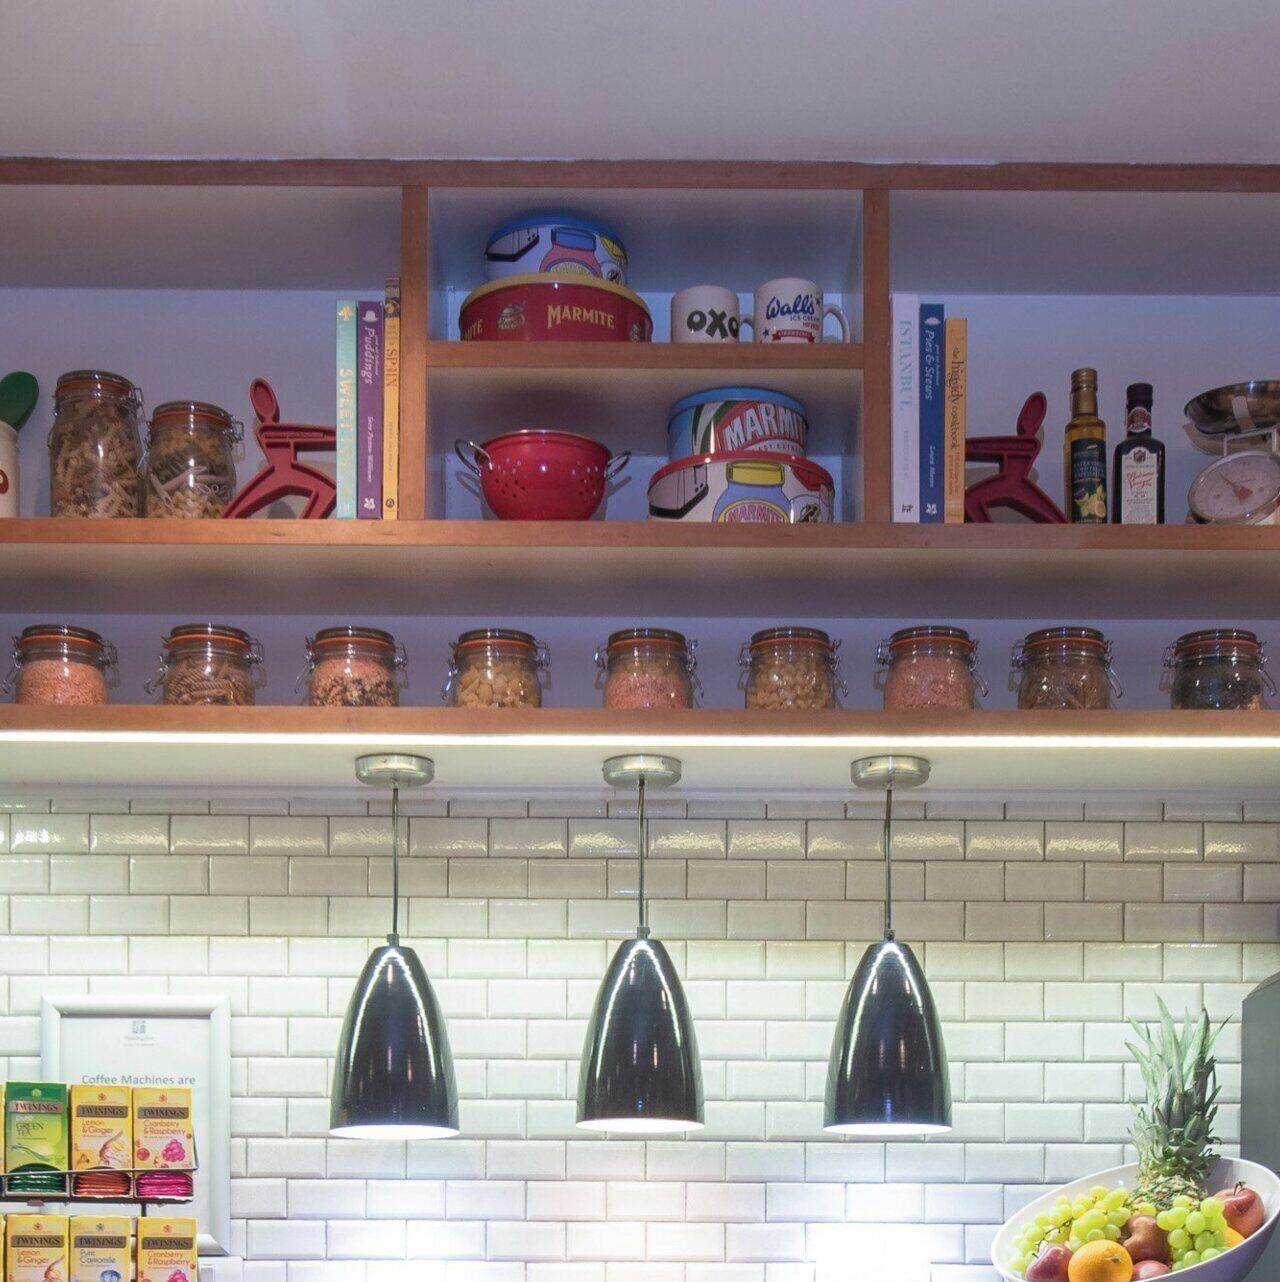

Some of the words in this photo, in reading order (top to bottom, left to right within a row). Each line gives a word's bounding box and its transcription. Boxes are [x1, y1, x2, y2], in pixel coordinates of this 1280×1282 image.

[766, 294, 816, 320] Wall's
[547, 304, 616, 330] MARMITE
[686, 308, 740, 340] OXO
[925, 330, 935, 353] Pies
[361, 327, 375, 385] Puddings
[925, 367, 935, 401] Stews
[946, 361, 964, 405] higgidy
[82, 1075, 118, 1085] Coffee
[121, 1075, 175, 1085] Machines
[178, 1077, 196, 1085] are
[15, 1102, 59, 1111] TWININGS
[82, 1107, 125, 1116] TWININGS
[143, 1109, 186, 1117] TWININGS
[16, 1236, 61, 1245] TWININGS
[79, 1237, 123, 1246] TWININGS
[146, 1238, 190, 1247] TWININGS
[147, 1250, 184, 1259] Cranberry
[80, 1256, 116, 1264] Camomile
